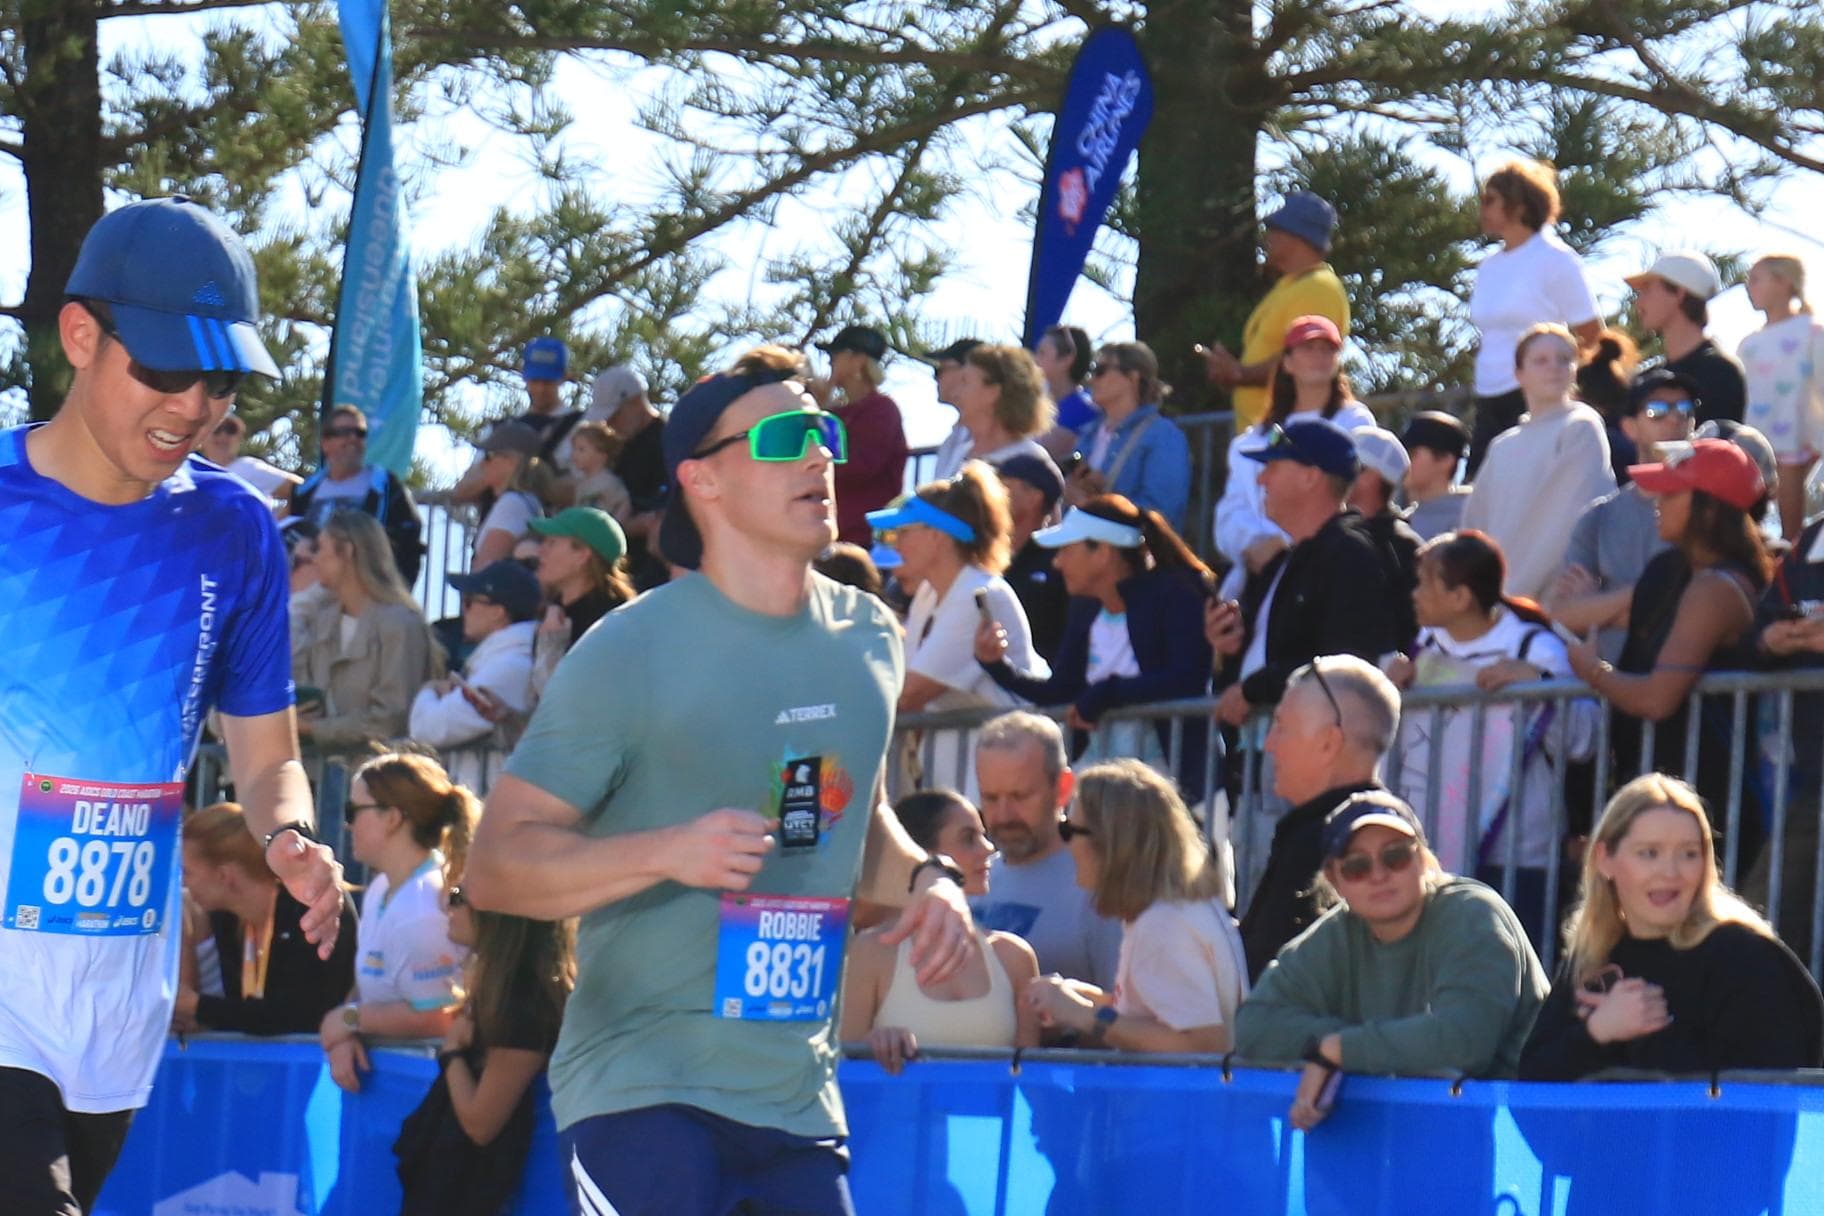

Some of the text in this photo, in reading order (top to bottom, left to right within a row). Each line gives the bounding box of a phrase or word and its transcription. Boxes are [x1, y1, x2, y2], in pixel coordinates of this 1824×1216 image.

[789, 703, 837, 722] TERREX
[71, 800, 152, 837] DEANO
[42, 836, 156, 908] 8878
[758, 910, 824, 941] ROBBIE
[744, 940, 826, 999] 8831
